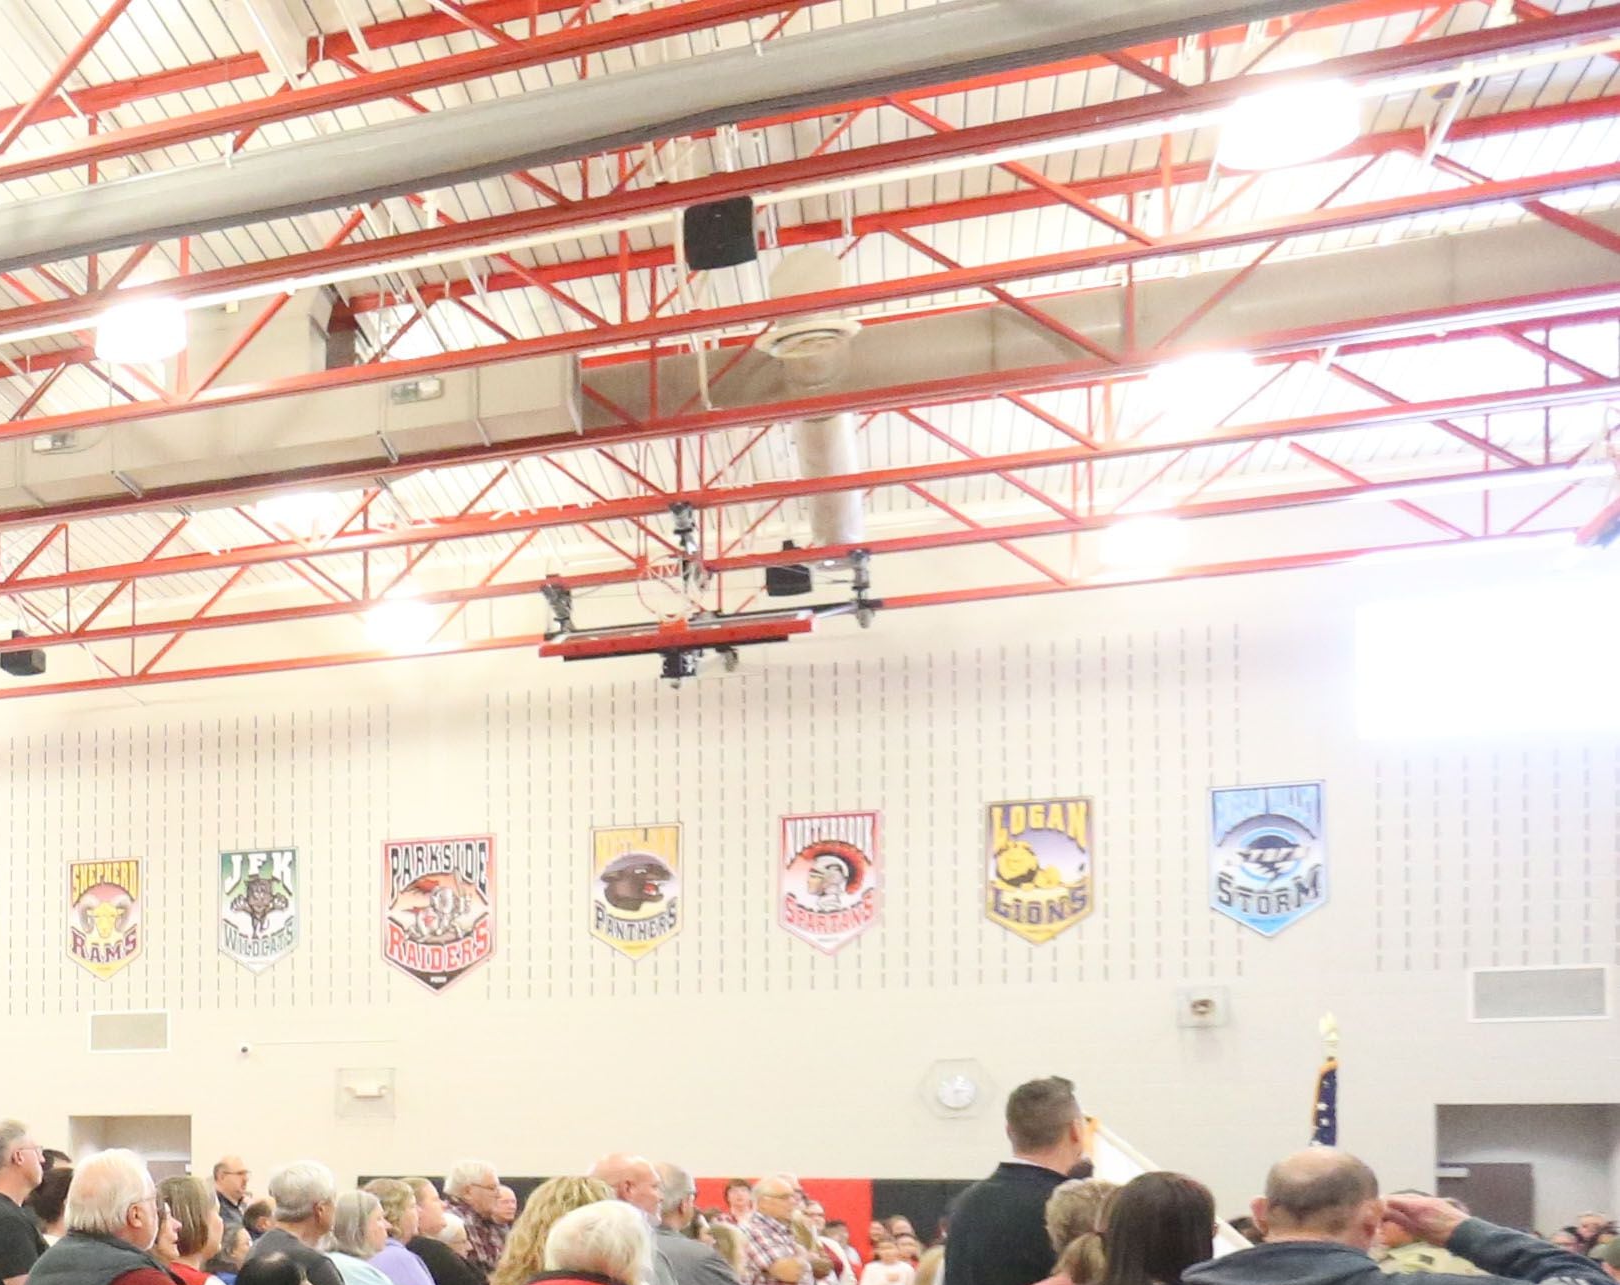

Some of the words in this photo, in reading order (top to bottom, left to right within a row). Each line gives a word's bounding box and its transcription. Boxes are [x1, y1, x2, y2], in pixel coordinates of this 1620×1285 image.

[990, 800, 1089, 850] LOGAN
[223, 851, 294, 896] JFK
[389, 840, 490, 906] PARKSIDE
[1216, 866, 1322, 916] STORM
[594, 900, 678, 942] PANTHERS
[785, 892, 875, 933] SPARTANS
[991, 886, 1089, 925] LIONS
[71, 927, 138, 963] RAMS
[223, 919, 295, 957] WILDCATS
[388, 919, 491, 971] RAIDERS
